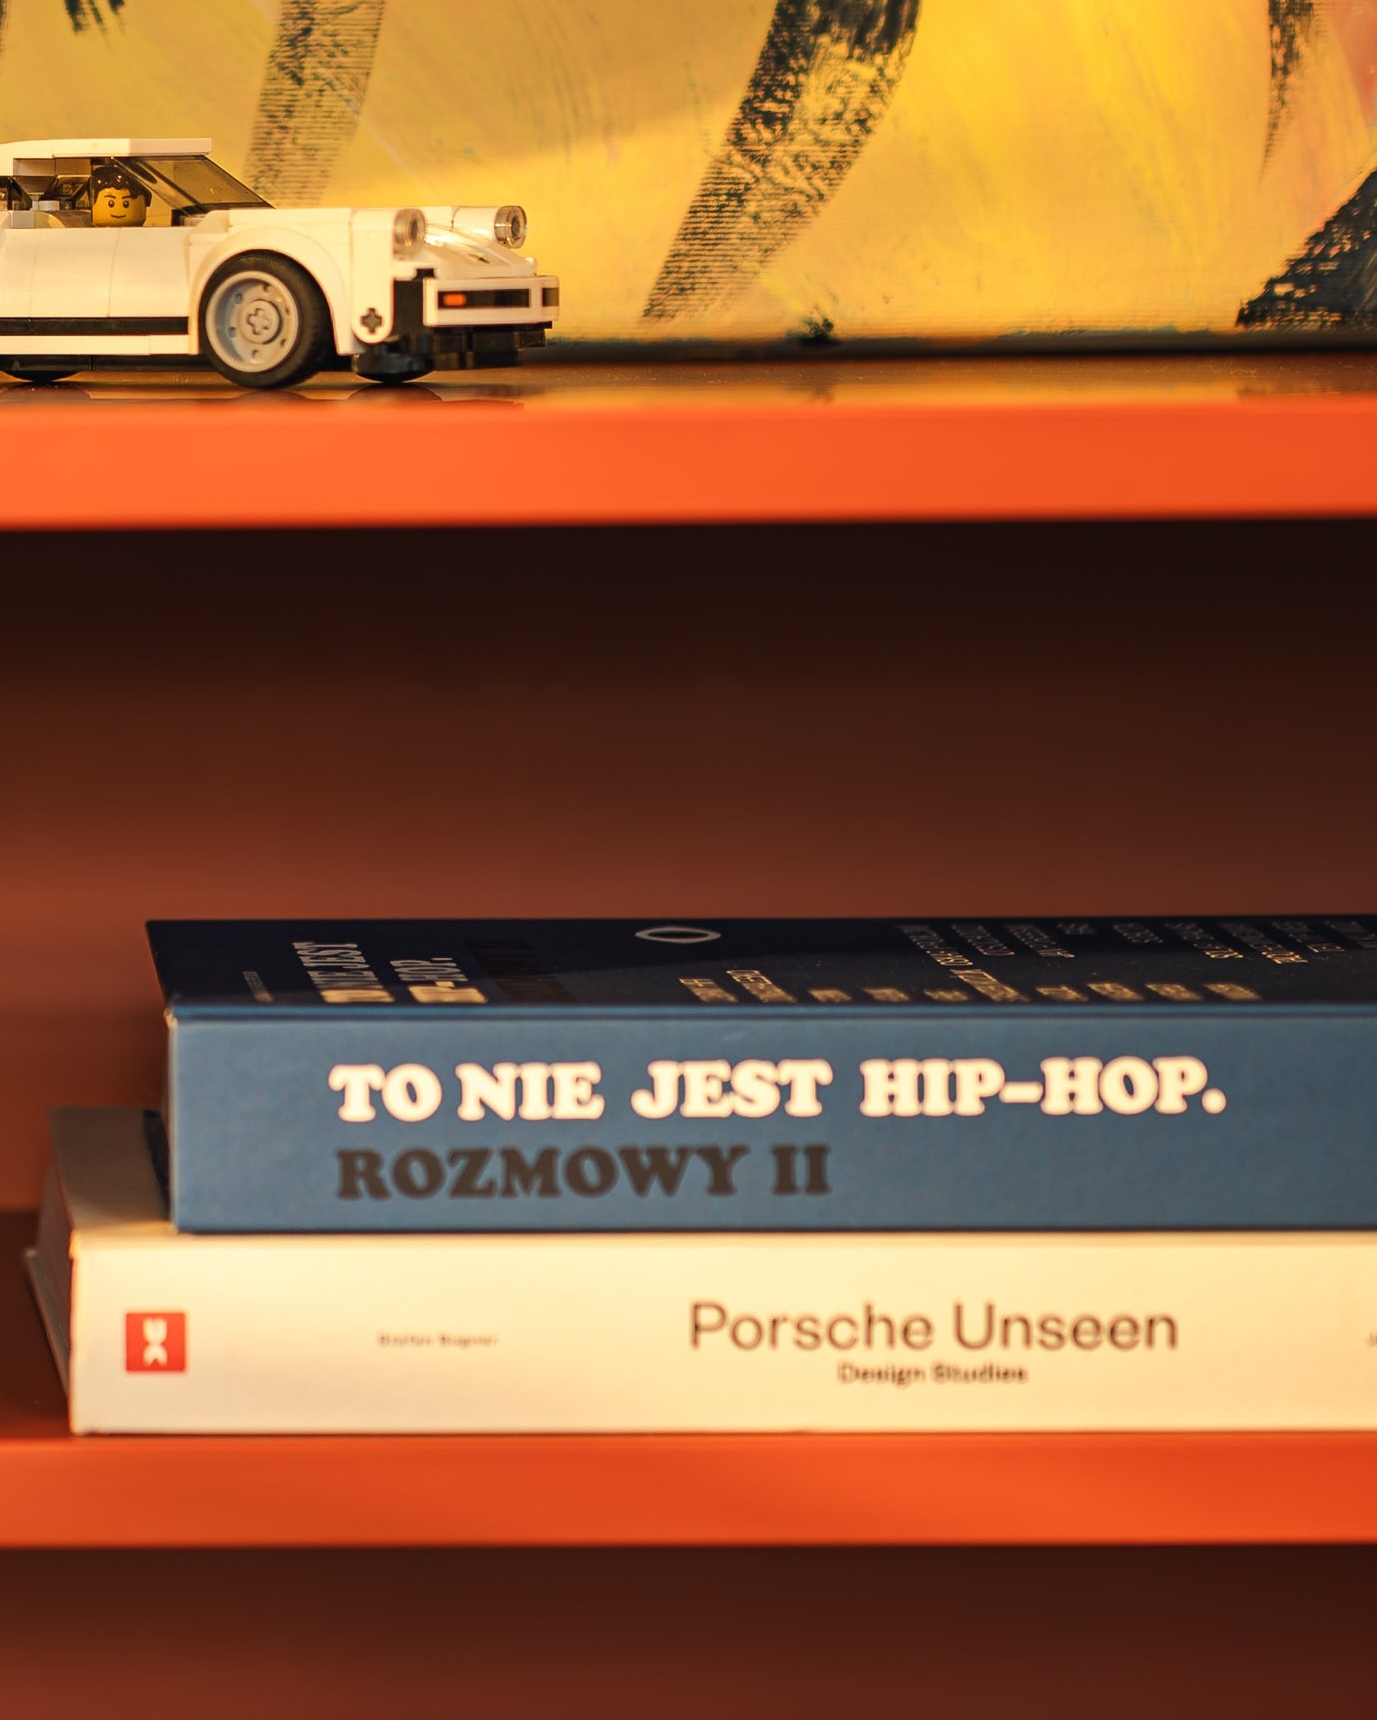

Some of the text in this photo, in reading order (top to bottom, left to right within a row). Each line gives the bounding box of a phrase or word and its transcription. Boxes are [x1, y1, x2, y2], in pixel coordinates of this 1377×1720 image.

[329, 1055, 1228, 1122] TO NIE JEST HIP-HOP.
[336, 1143, 832, 1200] ROZMOWY II
[689, 1299, 1180, 1350] Porsche Unseen
[838, 1361, 1030, 1388] Design Studies
